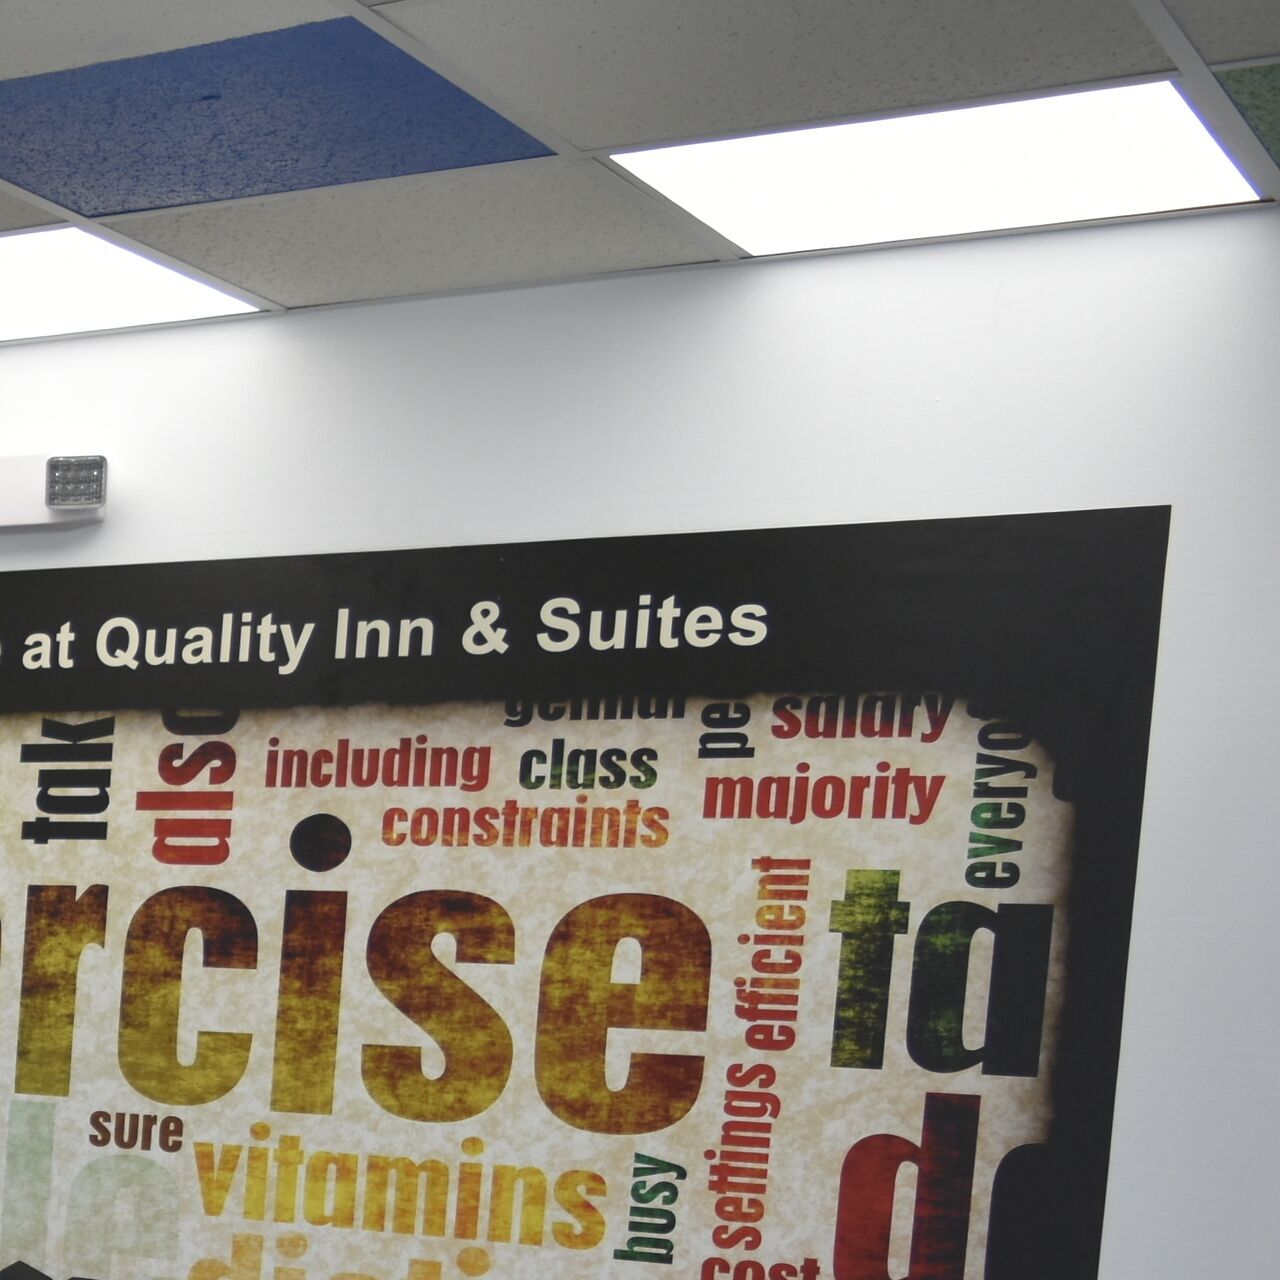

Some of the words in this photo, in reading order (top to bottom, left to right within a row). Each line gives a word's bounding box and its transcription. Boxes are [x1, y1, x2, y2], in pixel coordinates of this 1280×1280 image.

[22, 621, 75, 670] at
[96, 612, 315, 675] Quality
[333, 608, 435, 659] Inn
[461, 600, 510, 656] &
[536, 594, 768, 653] Suites
[265, 735, 492, 792] including
[518, 738, 658, 790] class
[771, 692, 954, 744] salary
[20, 715, 115, 845] talk
[135, 708, 240, 866] also
[381, 794, 671, 849] constraints
[702, 762, 946, 825] majority
[734, 855, 811, 1051] efficient
[829, 869, 1054, 1078] ta
[89, 1110, 184, 1153] sure
[704, 1063, 781, 1251] settings
[193, 1121, 607, 1251] vitamins
[613, 1152, 687, 1265] busy
